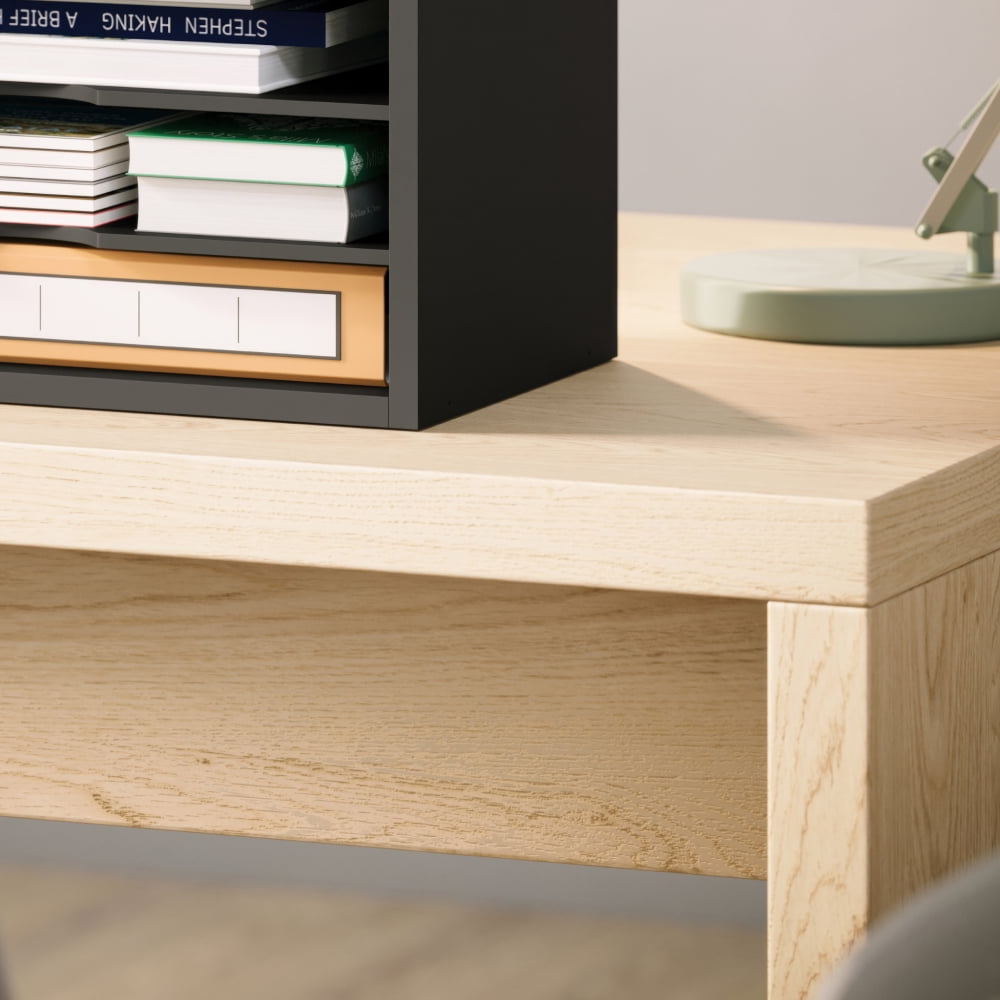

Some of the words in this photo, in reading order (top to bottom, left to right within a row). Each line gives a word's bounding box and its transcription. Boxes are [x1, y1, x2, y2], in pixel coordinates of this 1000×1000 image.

[8, 8, 61, 29] BRIEF
[65, 11, 79, 29] A
[101, 12, 172, 35] HAKING
[185, 16, 268, 38] STEPHEN
